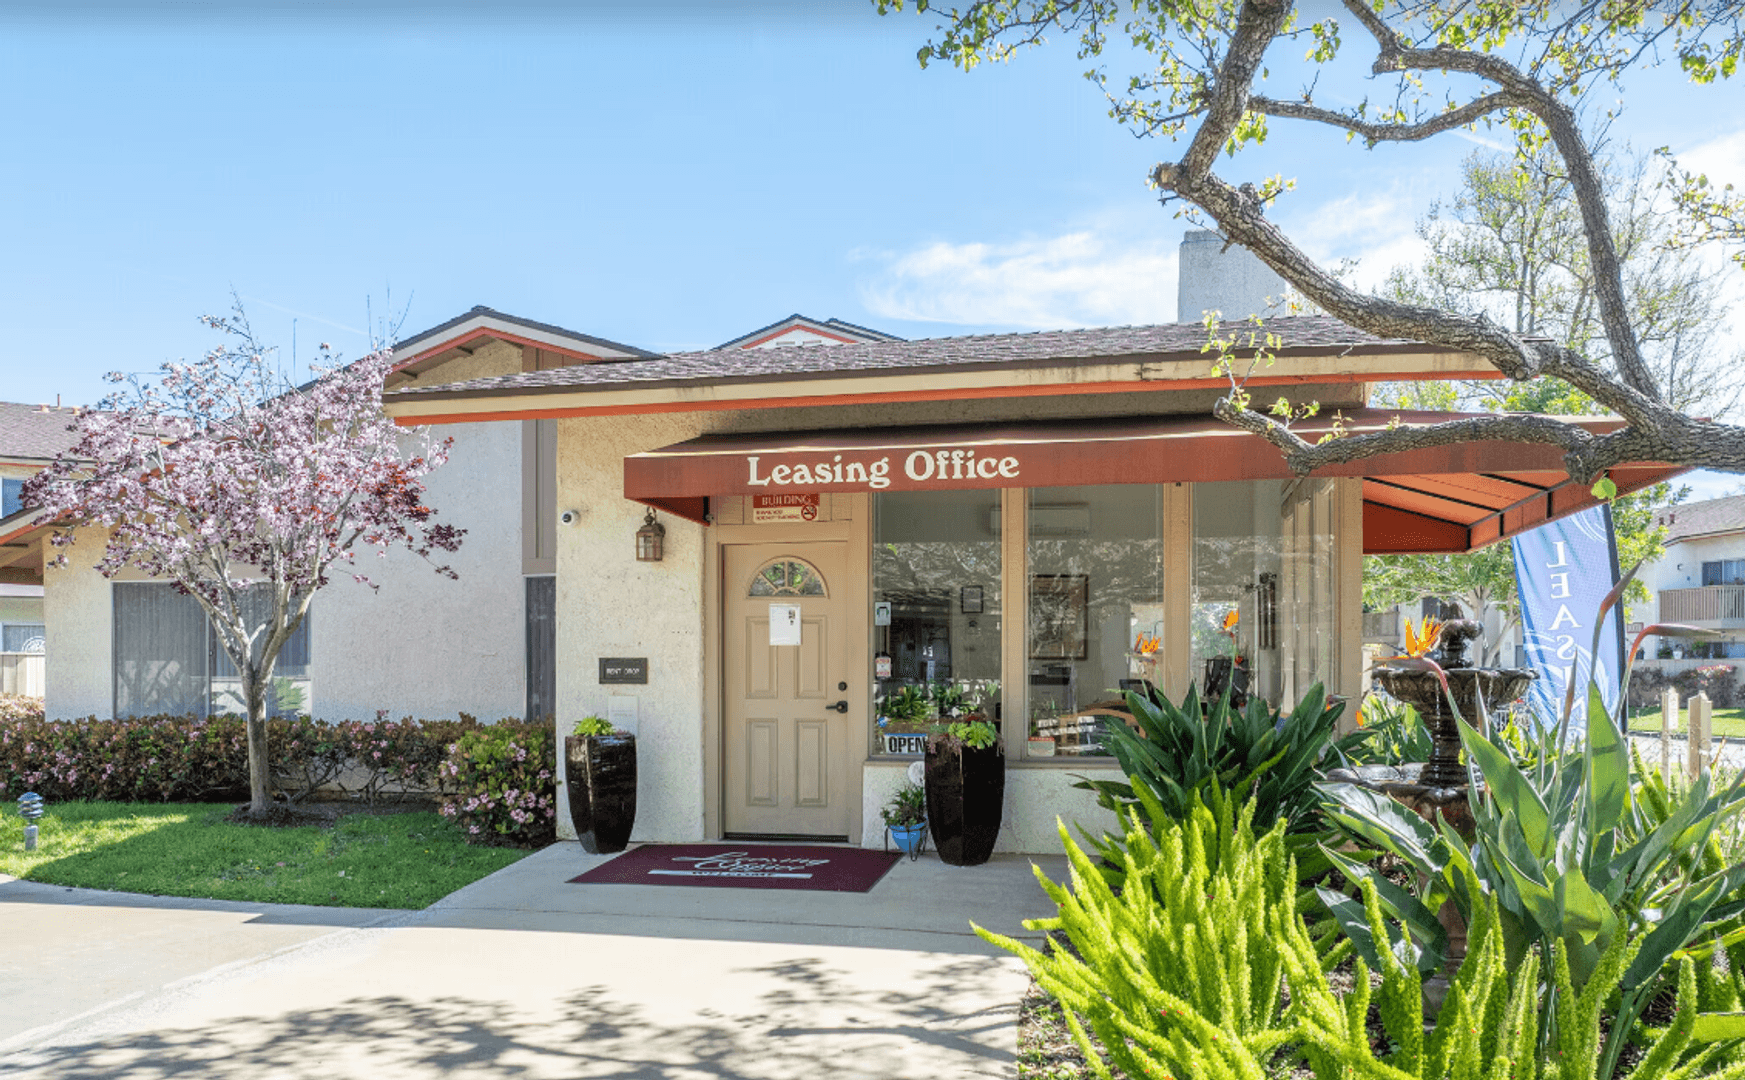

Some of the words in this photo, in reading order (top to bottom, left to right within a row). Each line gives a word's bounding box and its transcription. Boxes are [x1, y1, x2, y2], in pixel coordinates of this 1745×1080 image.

[747, 455, 892, 489] Leasing
[904, 449, 1021, 482] Office
[761, 494, 812, 507] BUILDING
[888, 735, 926, 753] OPEN
